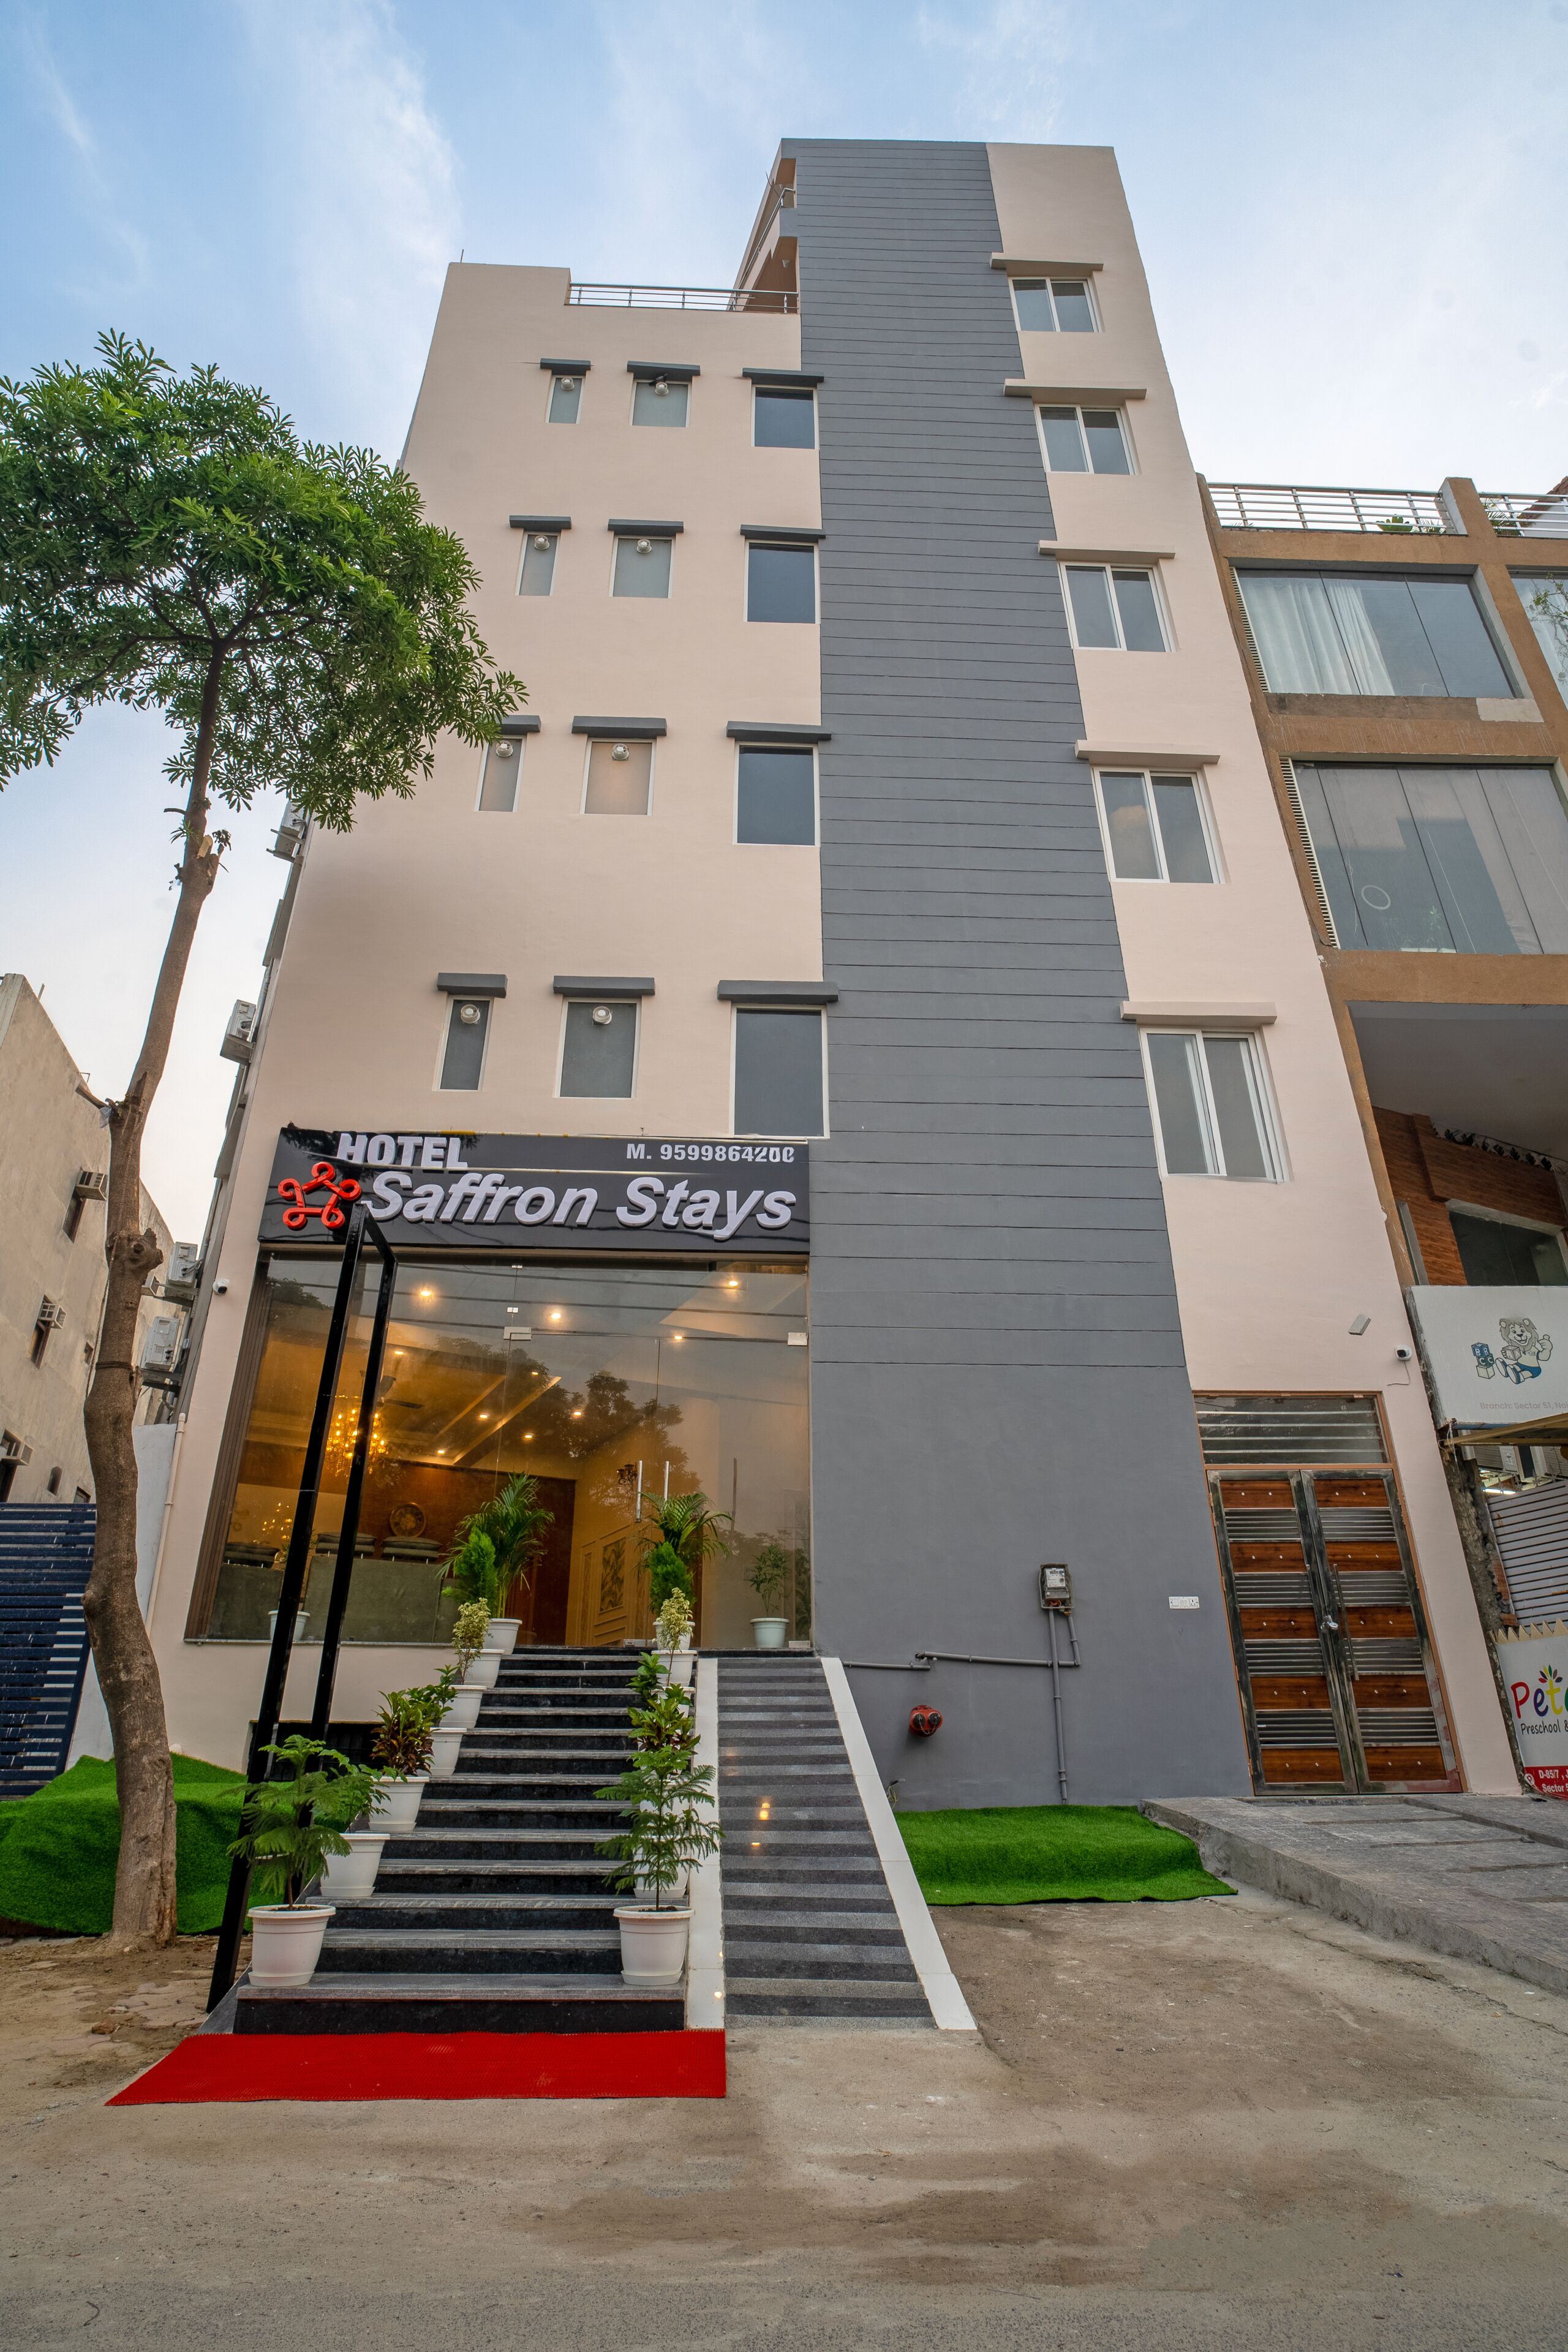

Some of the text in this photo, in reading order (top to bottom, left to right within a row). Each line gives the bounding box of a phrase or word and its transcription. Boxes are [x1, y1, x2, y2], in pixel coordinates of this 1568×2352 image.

[336, 1133, 468, 1169] HOTEL
[626, 1143, 652, 1159] M.
[360, 1170, 797, 1241] Saffron Stays
[1520, 1719, 1561, 1735] Preschool
[1542, 1783, 1564, 1793] Sector
